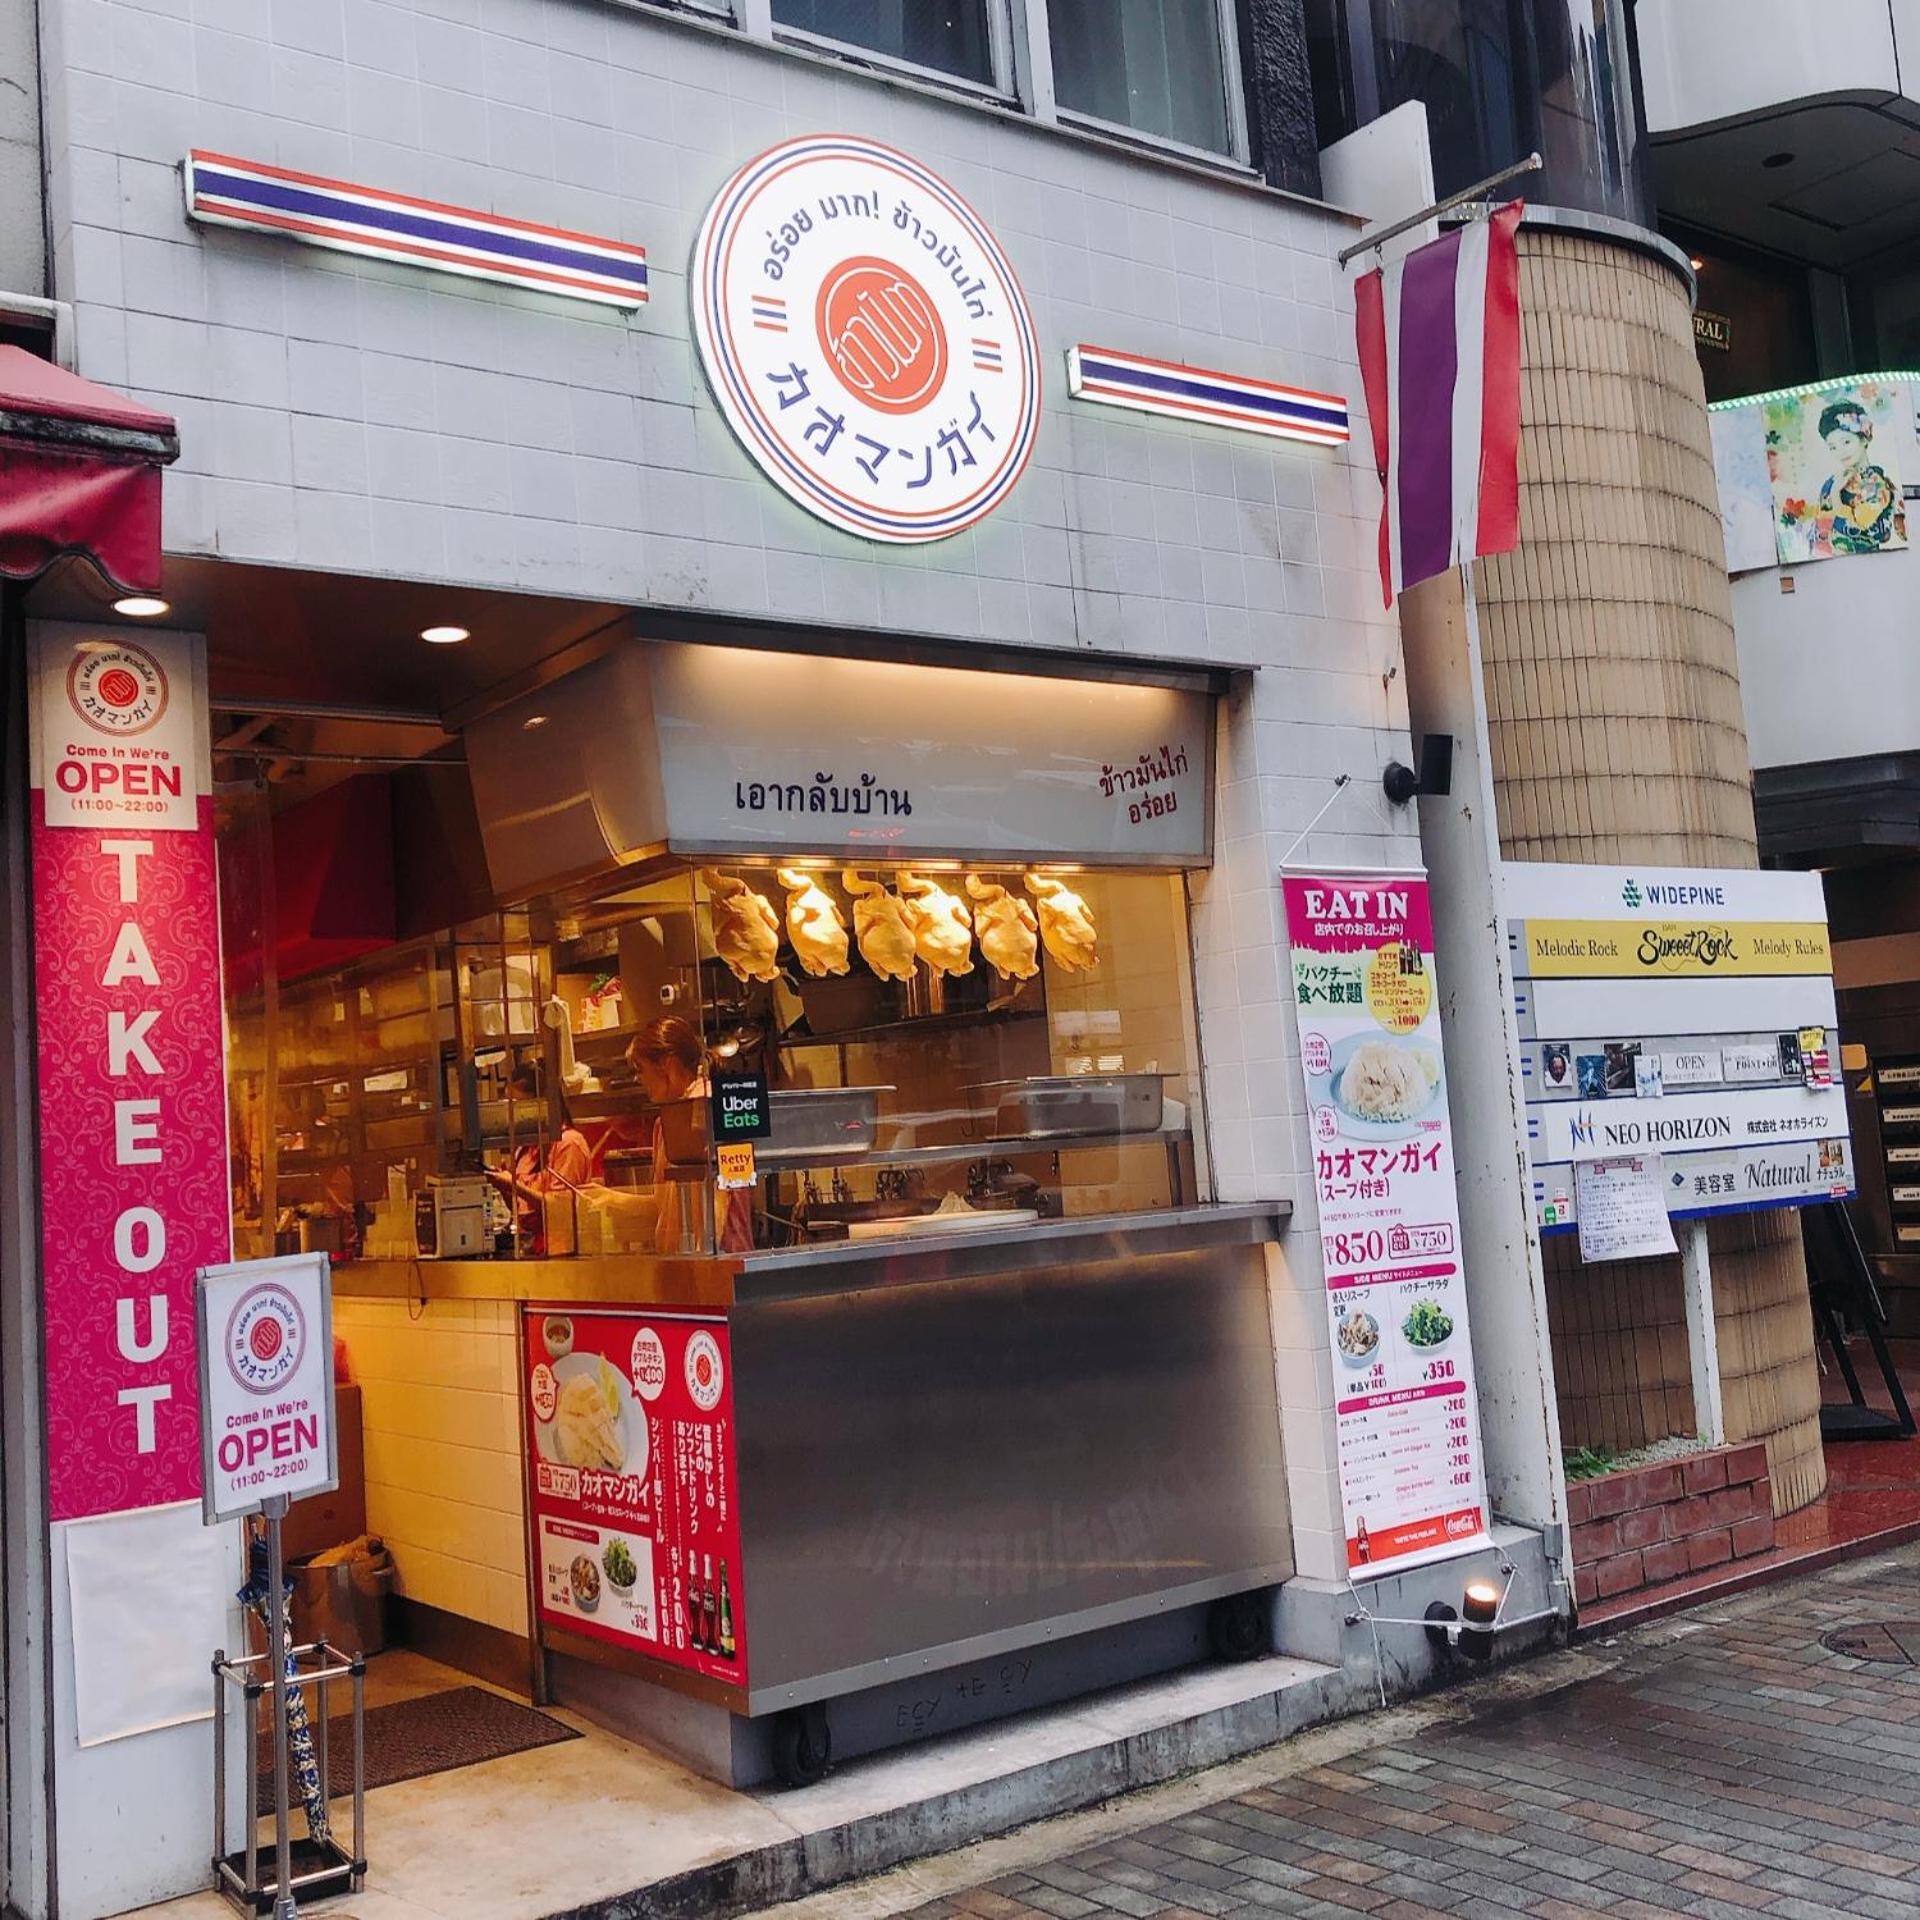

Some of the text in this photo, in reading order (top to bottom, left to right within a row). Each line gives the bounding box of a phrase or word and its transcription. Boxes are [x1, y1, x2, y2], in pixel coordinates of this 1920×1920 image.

[1694, 317, 1723, 340] RAL
[766, 362, 995, 489] カオマンガイ
[66, 744, 107, 757] Come
[129, 747, 170, 760] We're
[55, 760, 182, 797] OPEN
[1099, 745, 1188, 797] ข้าวมันไก่
[736, 772, 912, 816] เอากลับบ้าน
[1128, 791, 1177, 824] อร่อย
[1304, 890, 1408, 919] EAT IN
[1646, 886, 1725, 905] WIDEPINE
[1536, 939, 1618, 957] Melodic Rock
[1753, 938, 1824, 958] Melody Rules
[1297, 982, 1362, 1004] 食べ放題
[1676, 1055, 1705, 1070] OPEN
[722, 1096, 758, 1111] Uber
[724, 1113, 760, 1128] Eats
[1605, 1116, 1731, 1146] NEO HORIZON
[1747, 1117, 1829, 1134] 株式会社 ネオホライズン
[101, 839, 172, 1455] TAKE OUT
[720, 1154, 751, 1165] Retty
[1317, 1142, 1442, 1179] カオマンガイ
[1694, 1173, 1736, 1196] 美容室
[1744, 1154, 1811, 1189] Natural
[1816, 1167, 1846, 1182] ナチュラル
[1422, 1360, 1454, 1380] ¥350
[226, 1399, 308, 1428] Come In We're
[218, 1414, 318, 1473] OPEN
[231, 1458, 308, 1491] (11:00~22:00)
[582, 1471, 649, 1506] カオマンガイ
[685, 1422, 699, 1535] ソフトドリンク
